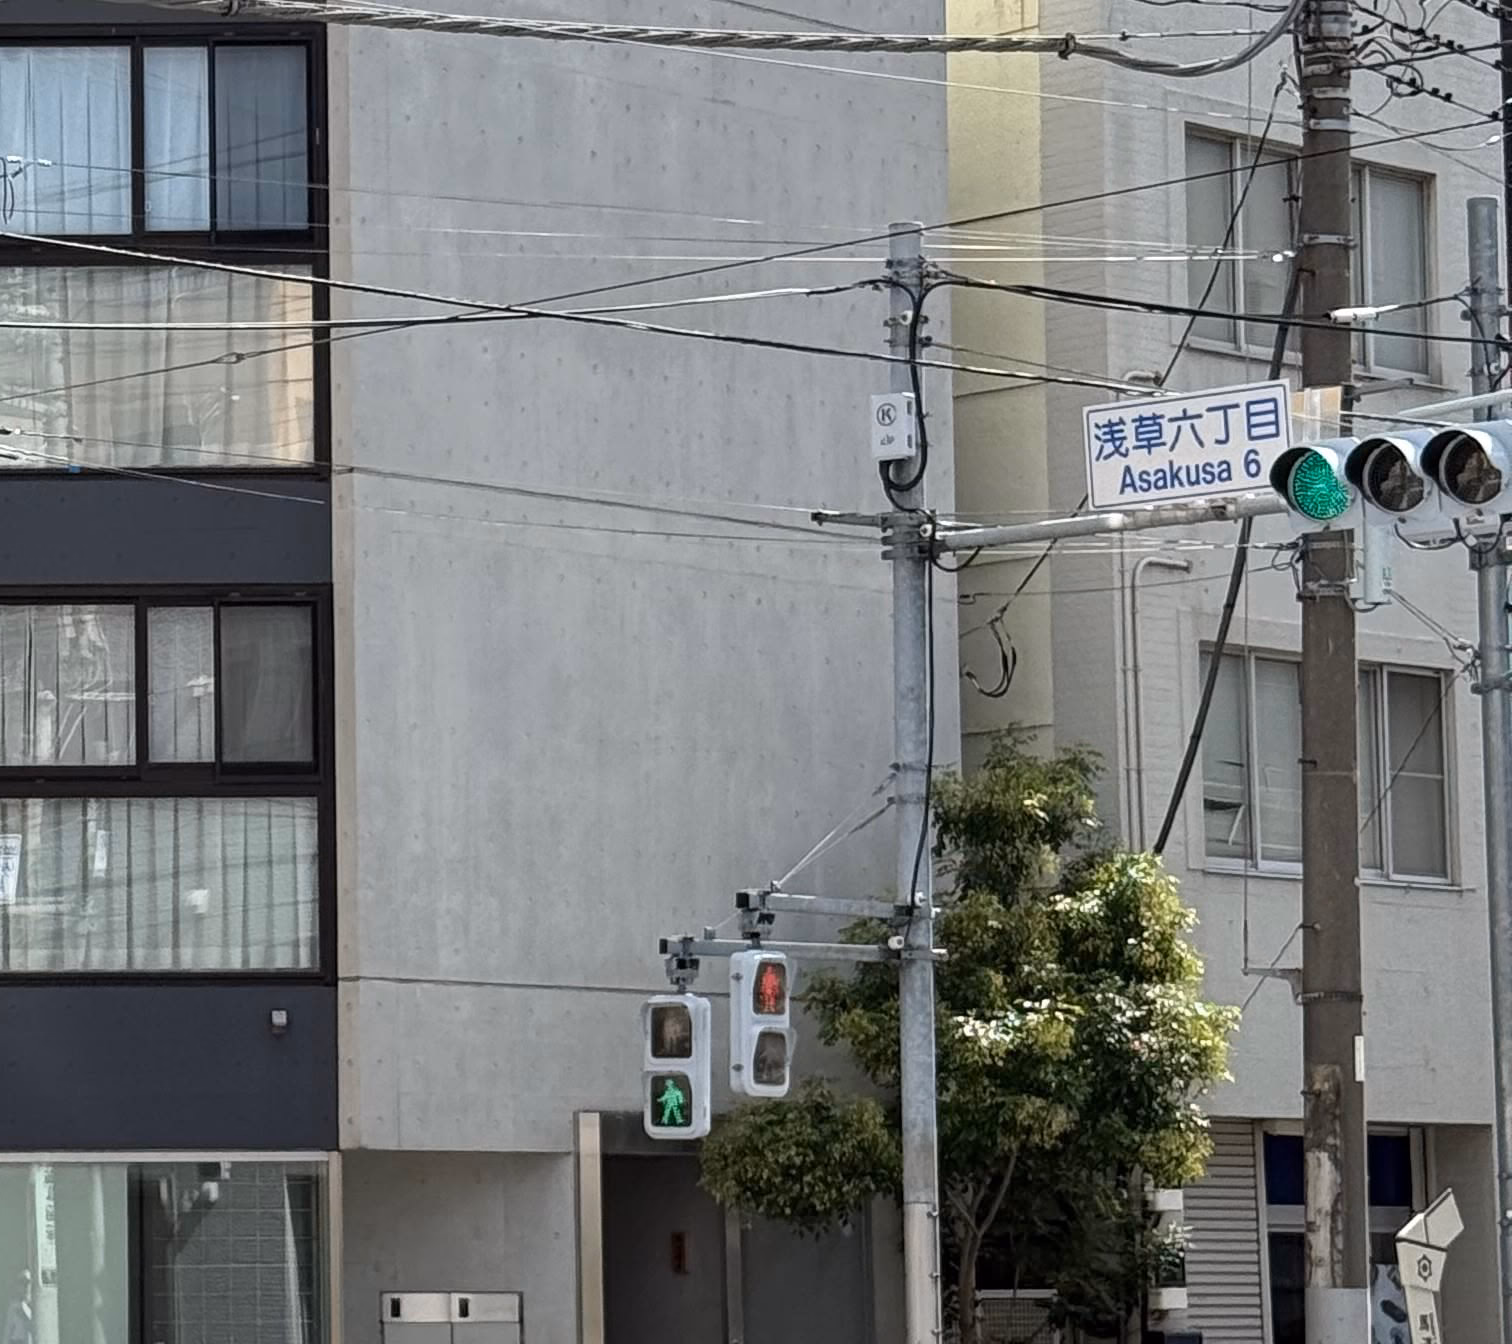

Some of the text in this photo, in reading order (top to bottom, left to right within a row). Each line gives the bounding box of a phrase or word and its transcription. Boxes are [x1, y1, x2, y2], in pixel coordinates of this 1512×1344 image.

[1094, 397, 1281, 462] 浅草六丁目
[1119, 448, 1262, 495] Asakusa 6
